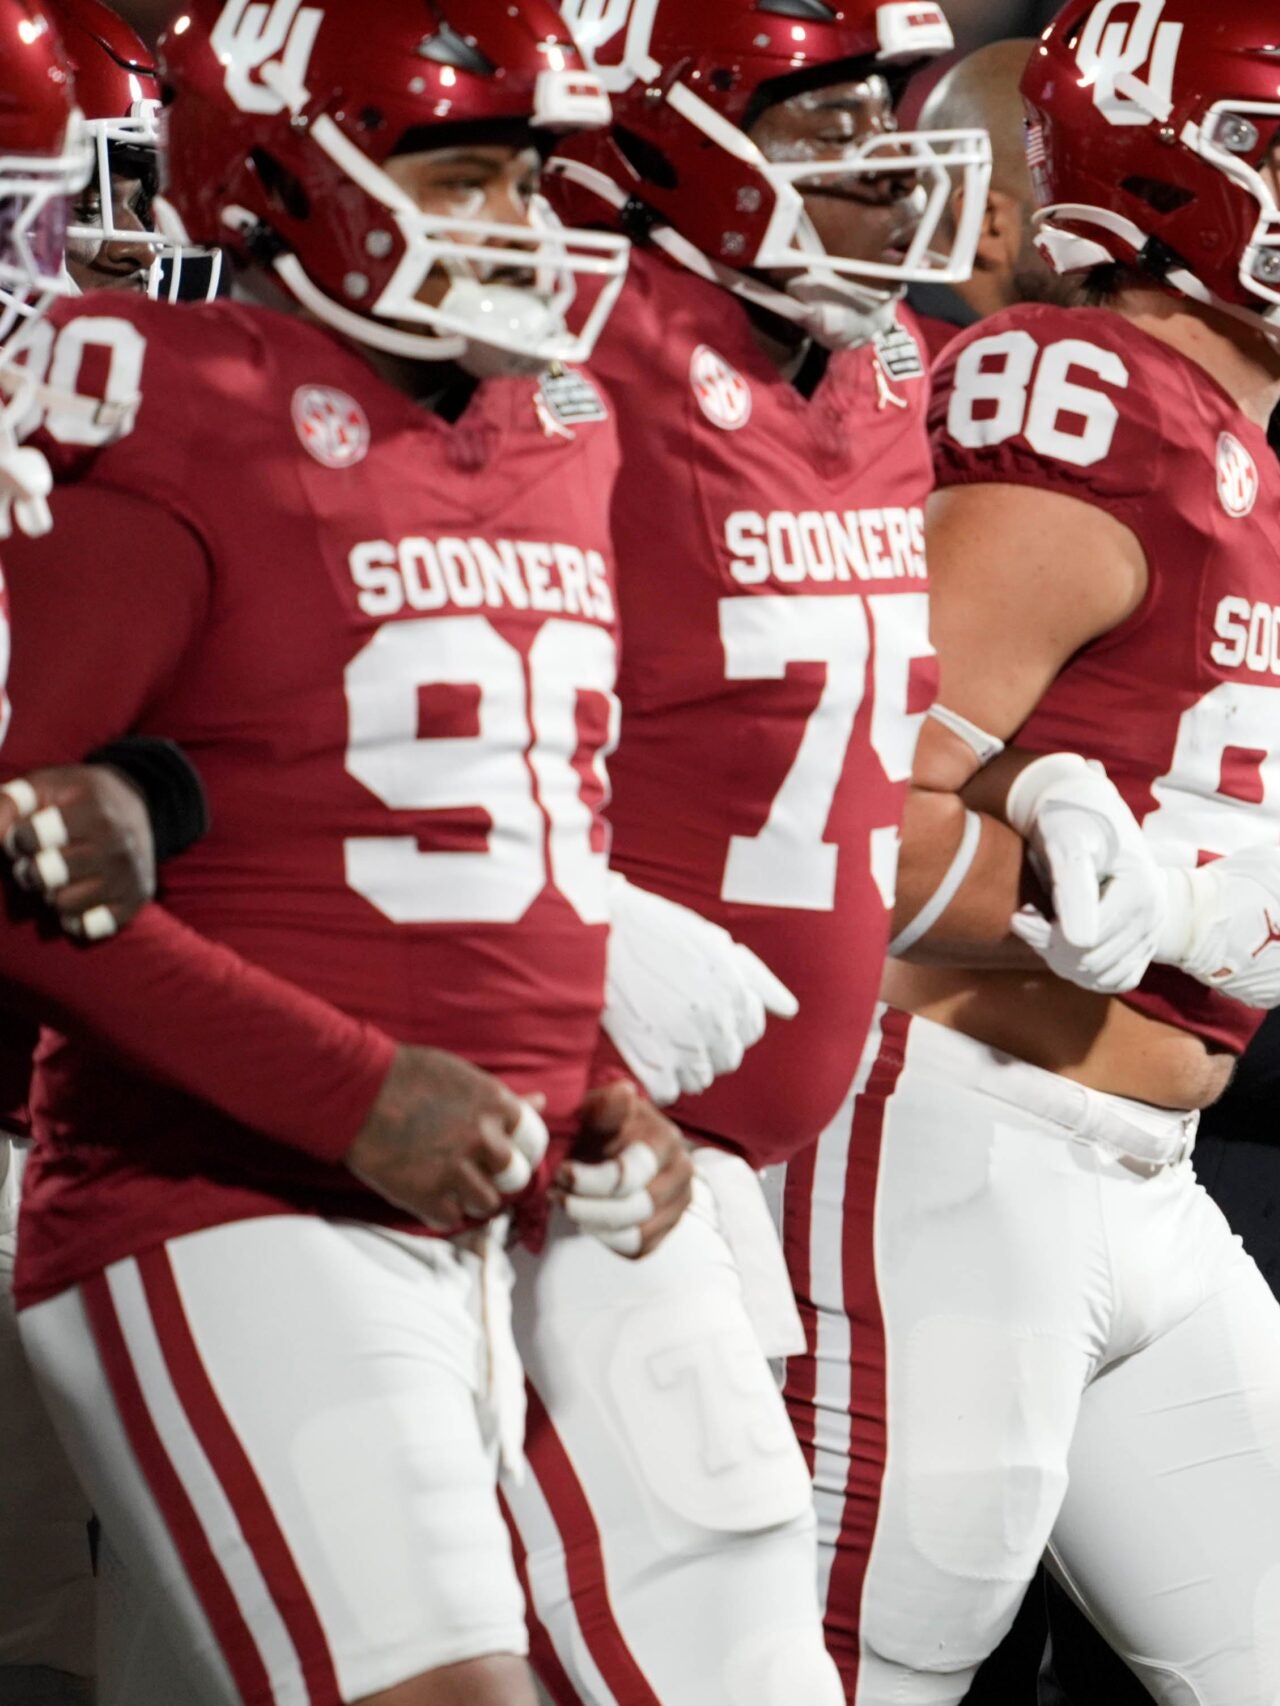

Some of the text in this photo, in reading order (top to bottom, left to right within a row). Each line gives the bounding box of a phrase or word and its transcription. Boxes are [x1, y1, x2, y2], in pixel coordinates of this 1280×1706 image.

[1075, 0, 1184, 126] OU
[947, 330, 1128, 466] 86
[349, 536, 615, 623] SOONERS
[344, 614, 622, 926] 90
